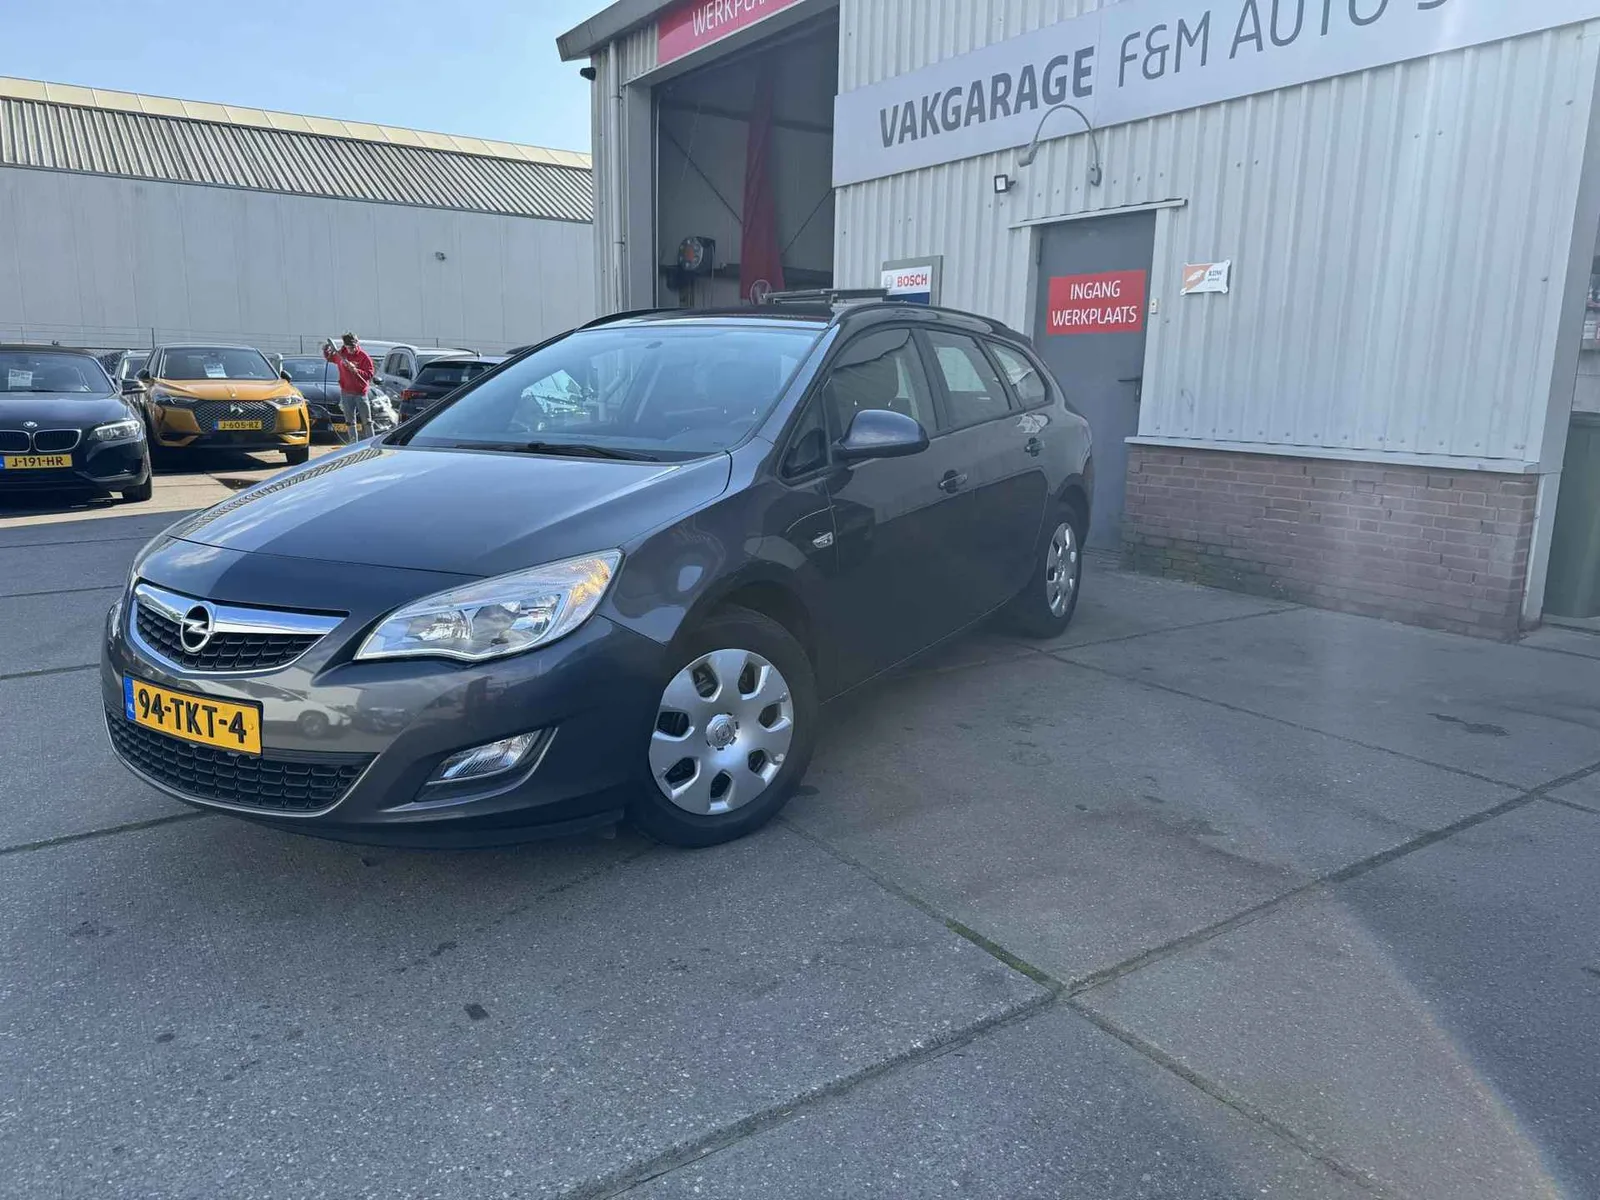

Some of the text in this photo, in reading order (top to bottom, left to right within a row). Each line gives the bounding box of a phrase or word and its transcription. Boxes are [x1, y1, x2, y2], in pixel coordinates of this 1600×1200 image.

[692, 0, 765, 36] WERKPL
[880, 46, 1095, 148] VAKGARAGE
[1118, 10, 1211, 88] F&M
[897, 273, 928, 288] BOSCH
[1070, 280, 1121, 301] INGANG
[1052, 305, 1138, 327] WERKPLAATS
[12, 456, 64, 467] J-191-HR
[138, 688, 248, 743] 94-TKT-4
